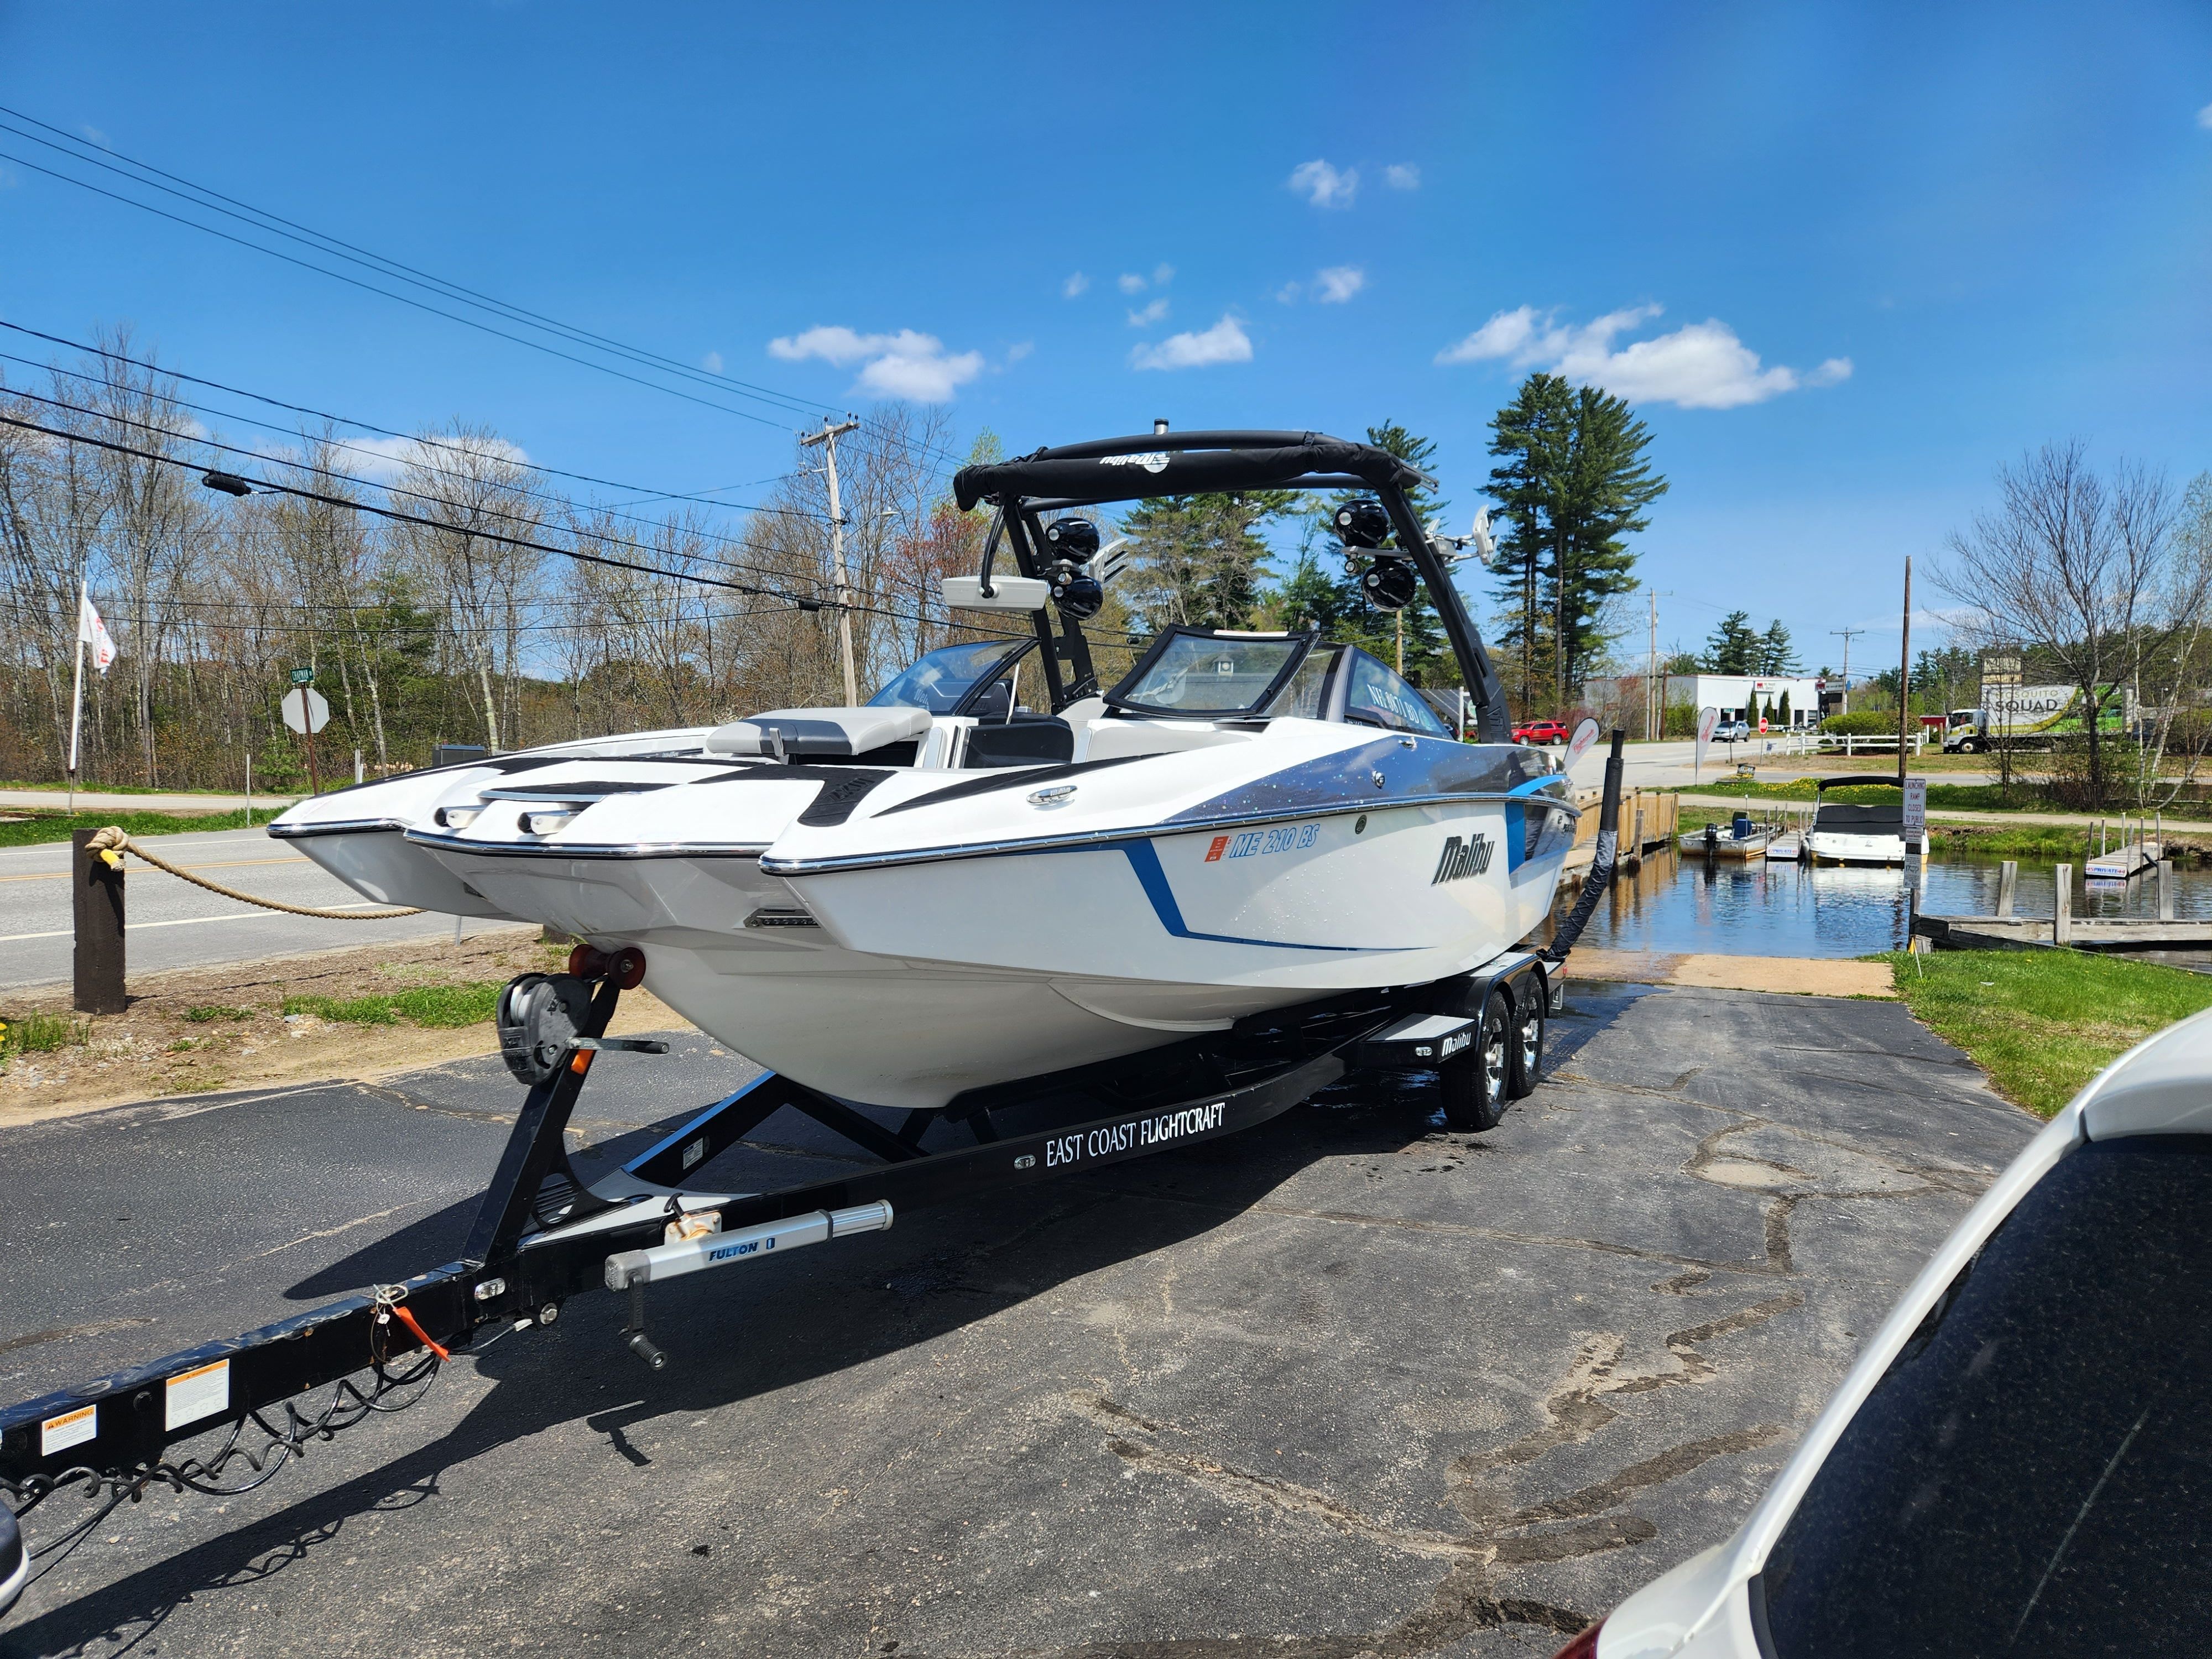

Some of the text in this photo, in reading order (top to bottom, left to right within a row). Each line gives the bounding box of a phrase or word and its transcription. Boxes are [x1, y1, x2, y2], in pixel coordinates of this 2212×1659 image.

[1099, 453, 1156, 466] Malibu
[1995, 699, 2058, 712] SQUAD
[1911, 815, 1923, 823] PUBLIC
[1229, 832, 1264, 858] ME
[1262, 827, 1297, 854] 210
[1296, 823, 1321, 849] BS
[1431, 833, 1495, 886] Malibu
[1442, 1031, 1472, 1057] Malibu
[1046, 1102, 1225, 1167] EAST COAST FLIGHTCRAFT
[708, 1241, 759, 1263] FULTON
[55, 1408, 93, 1426] WARNING
